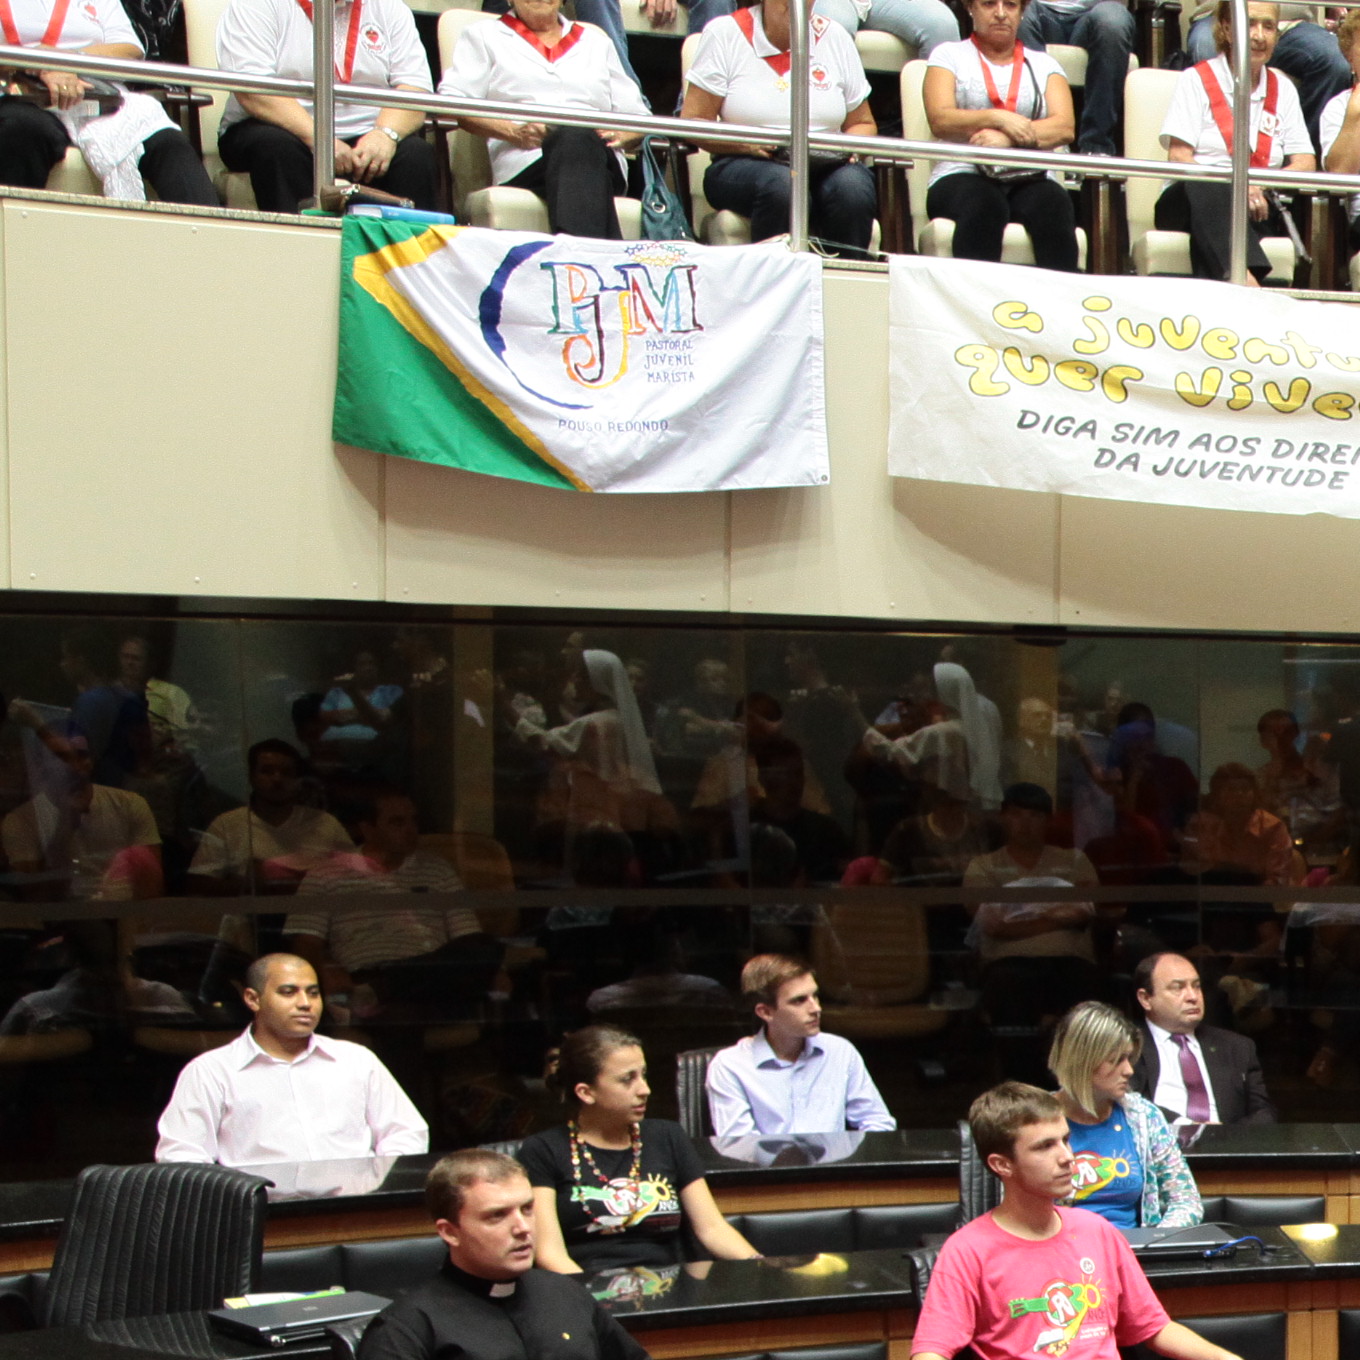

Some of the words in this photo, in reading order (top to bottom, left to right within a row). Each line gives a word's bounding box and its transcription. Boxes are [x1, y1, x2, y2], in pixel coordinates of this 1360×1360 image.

[645, 340, 693, 350] PASTORAL
[644, 354, 694, 369] JUVENIL
[647, 371, 695, 383] MARISTA
[954, 343, 1144, 404] quer
[558, 418, 601, 433] POUSO
[608, 419, 669, 433] REDONDO
[1016, 408, 1098, 441] DIGA
[1111, 421, 1180, 449] SIM
[1188, 431, 1262, 458] AOS
[1093, 446, 1141, 473] DA
[1152, 456, 1350, 490] JUVENTUDE
